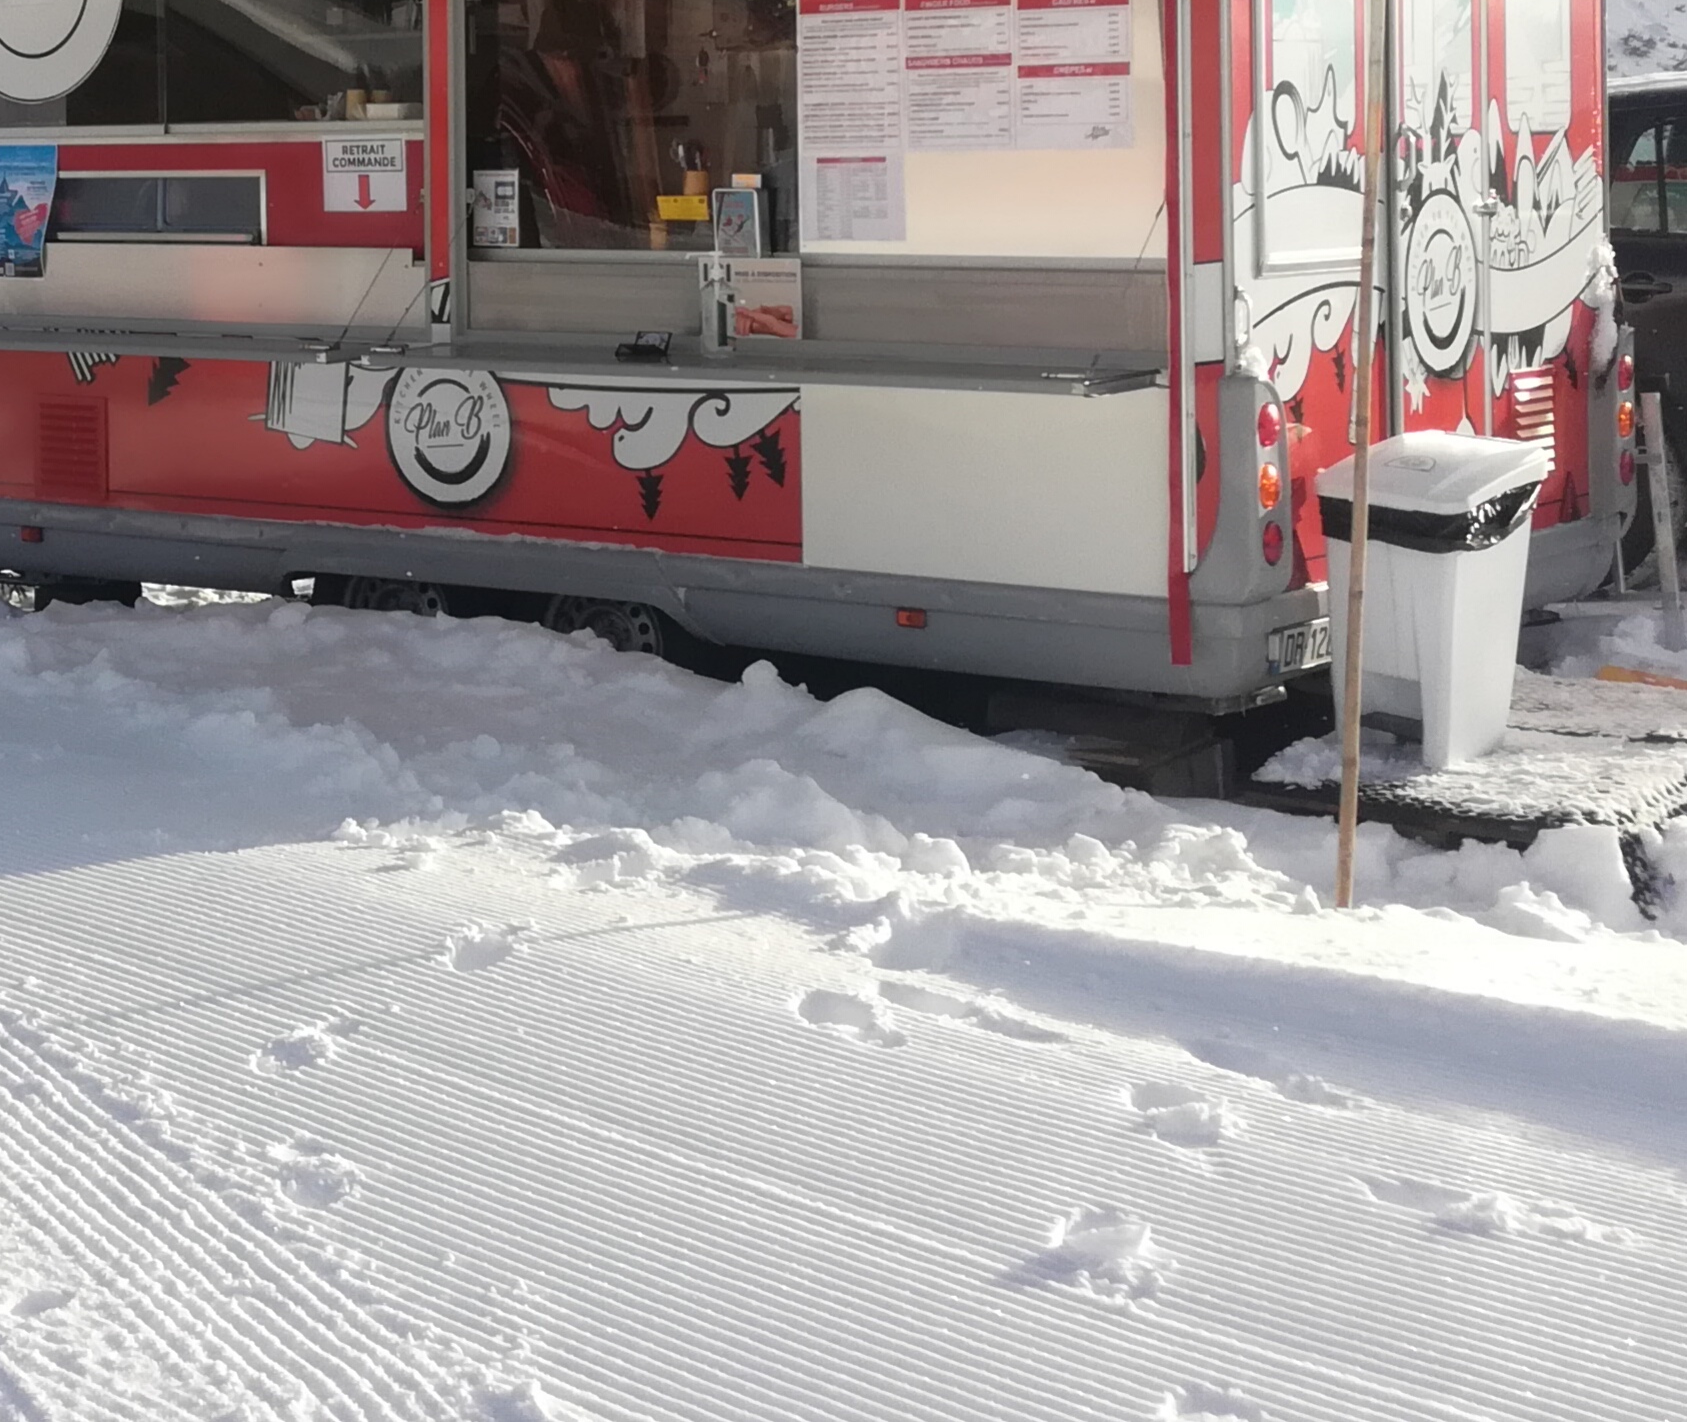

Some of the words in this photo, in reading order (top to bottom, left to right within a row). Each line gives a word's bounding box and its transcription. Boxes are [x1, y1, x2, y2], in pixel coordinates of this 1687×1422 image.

[332, 156, 396, 168] COMMANDE
[342, 144, 385, 155] RETRAIT
[1416, 258, 1444, 311] Plan
[1446, 244, 1462, 296] B
[404, 402, 451, 444] Plan
[455, 395, 484, 440] B
